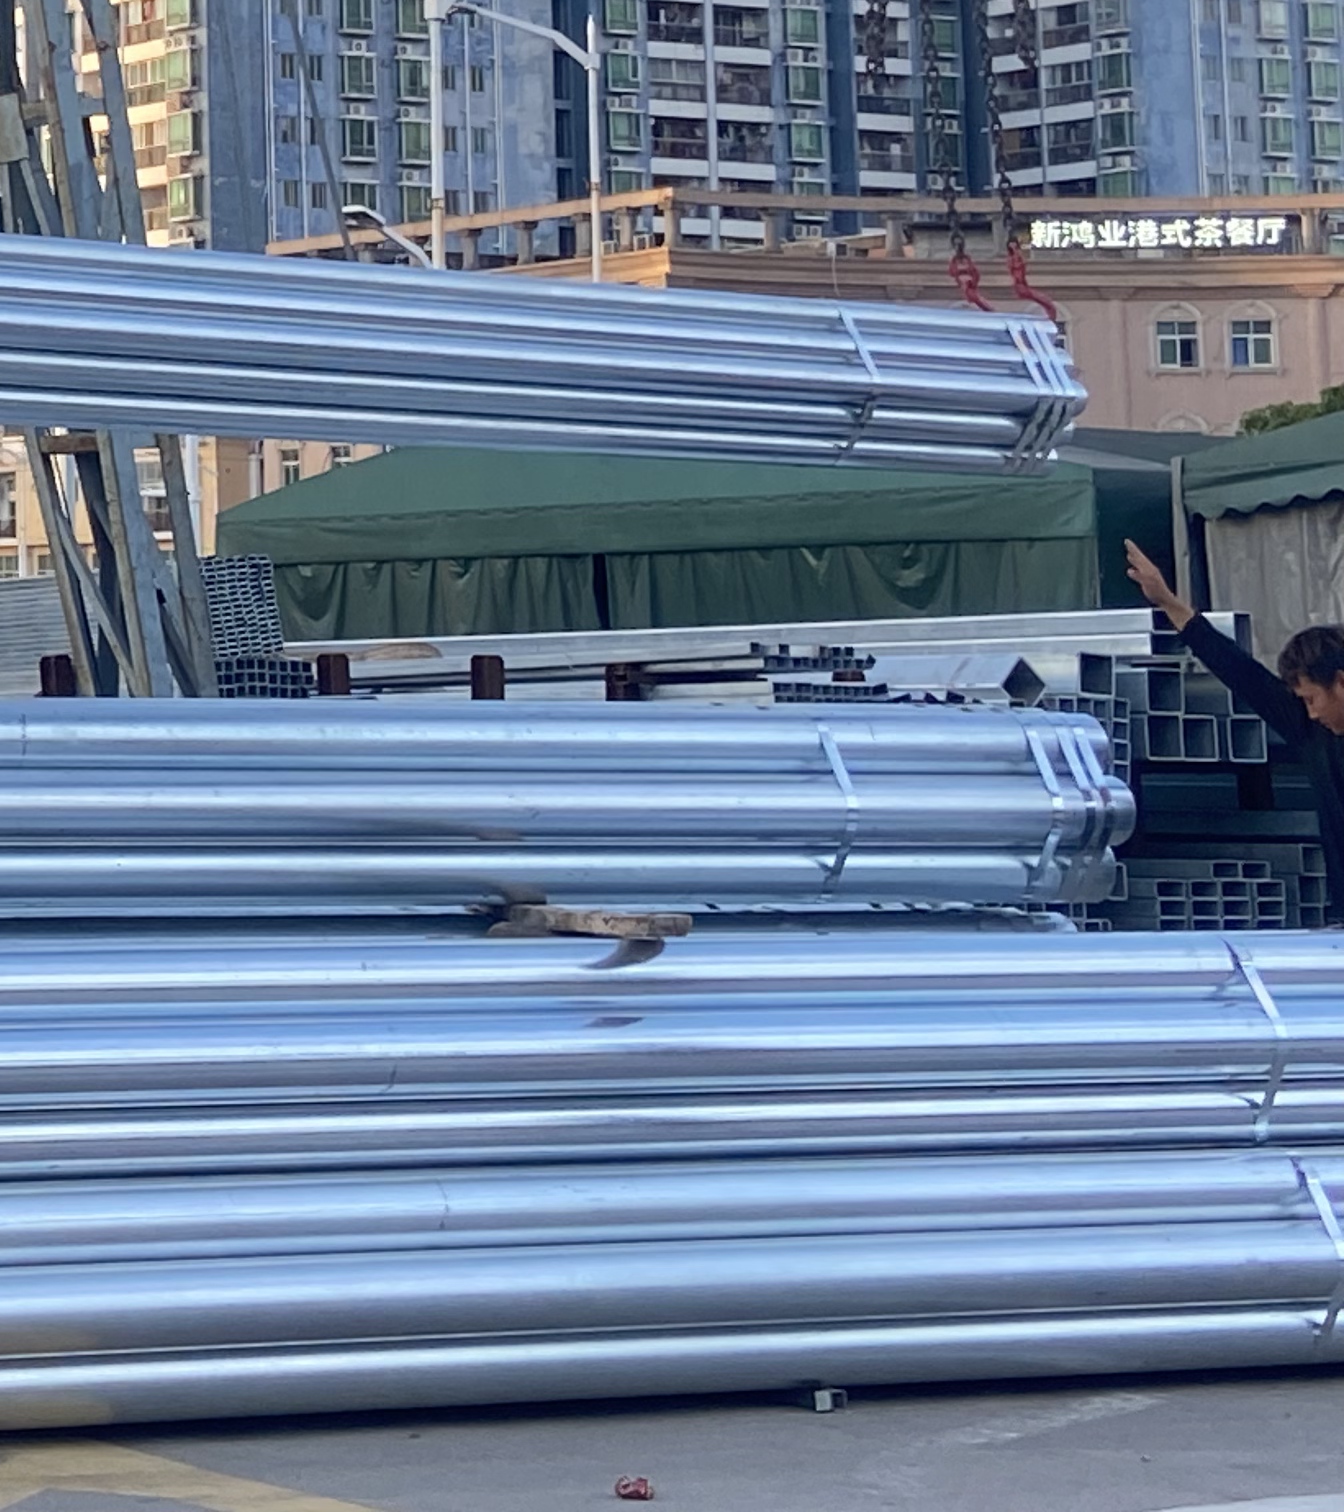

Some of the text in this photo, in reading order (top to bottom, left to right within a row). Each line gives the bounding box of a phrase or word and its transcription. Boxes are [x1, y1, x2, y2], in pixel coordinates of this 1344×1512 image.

[1030, 217, 1287, 249] 新鸿业港式茶餐厅
